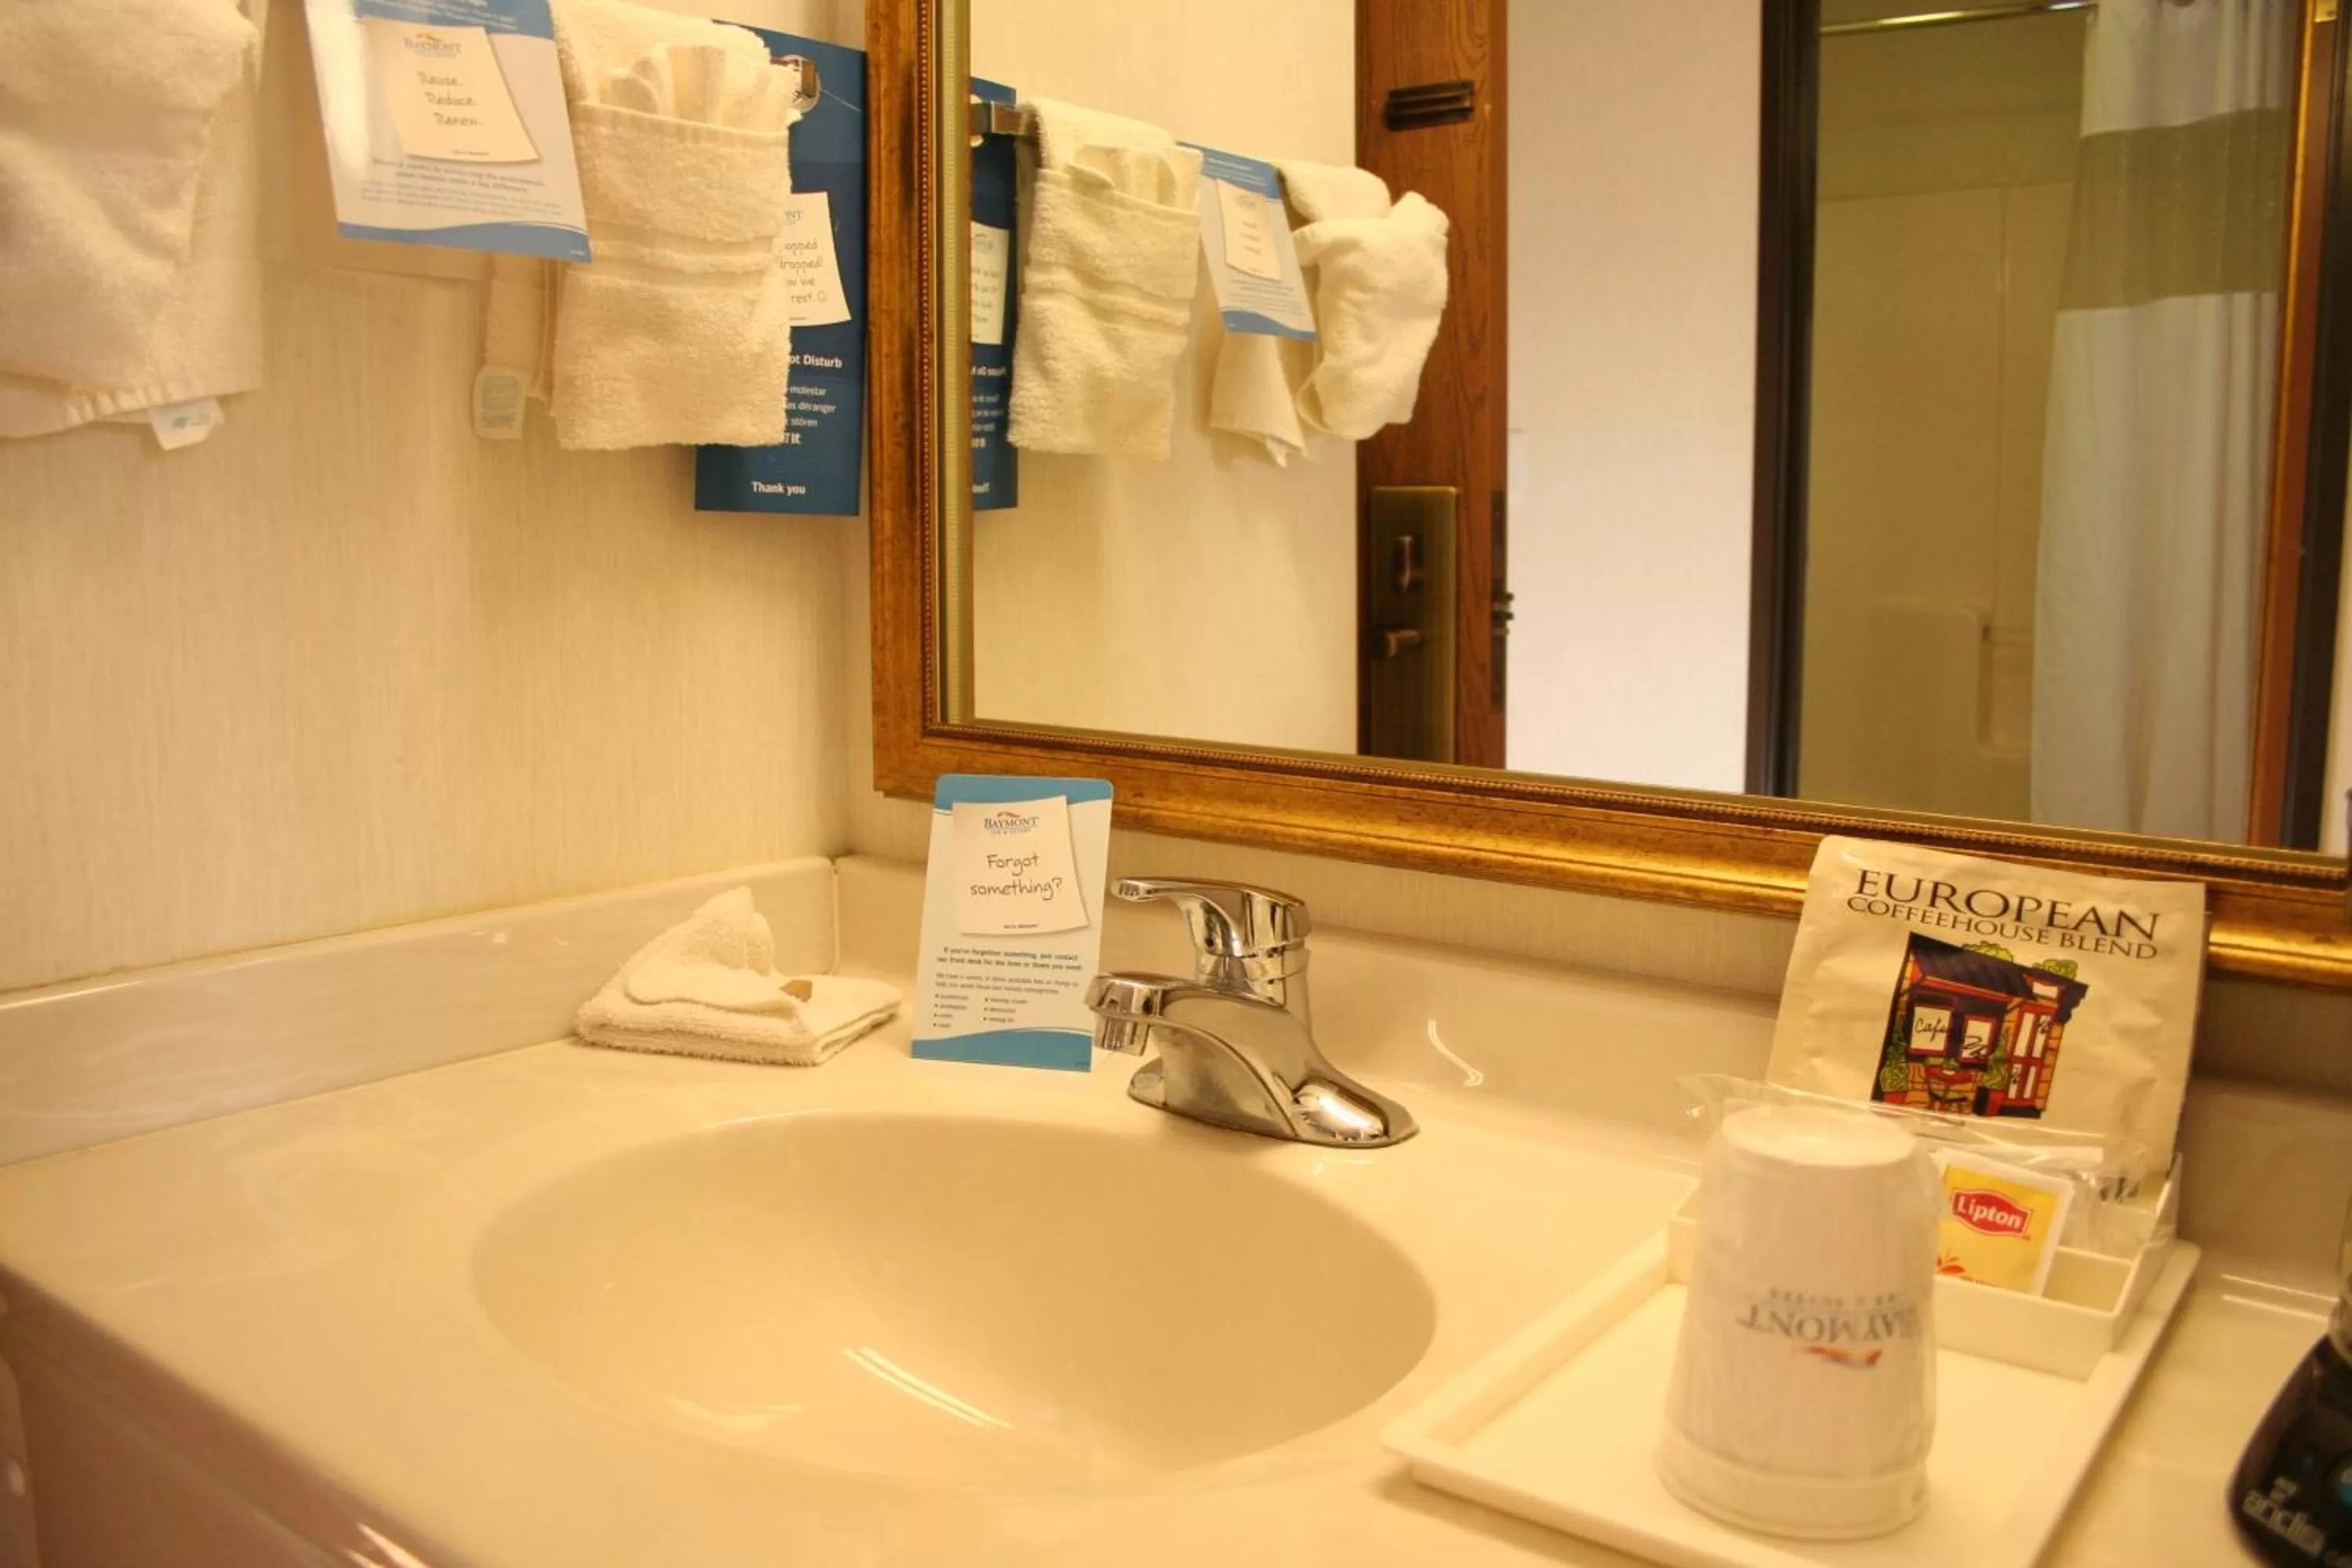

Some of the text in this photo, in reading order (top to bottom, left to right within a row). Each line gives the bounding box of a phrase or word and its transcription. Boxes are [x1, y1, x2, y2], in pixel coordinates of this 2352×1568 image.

[789, 354, 844, 368] ot Disturb
[752, 481, 805, 495] Thank you
[984, 817, 1040, 829] BAYMONT
[986, 852, 1040, 877] Forgot
[970, 877, 1062, 901] something?
[1854, 868, 2161, 941] EUROPEAN
[1846, 895, 2158, 960] COFFEEHOUSE BLEND
[1958, 1196, 2023, 1230] Lipton
